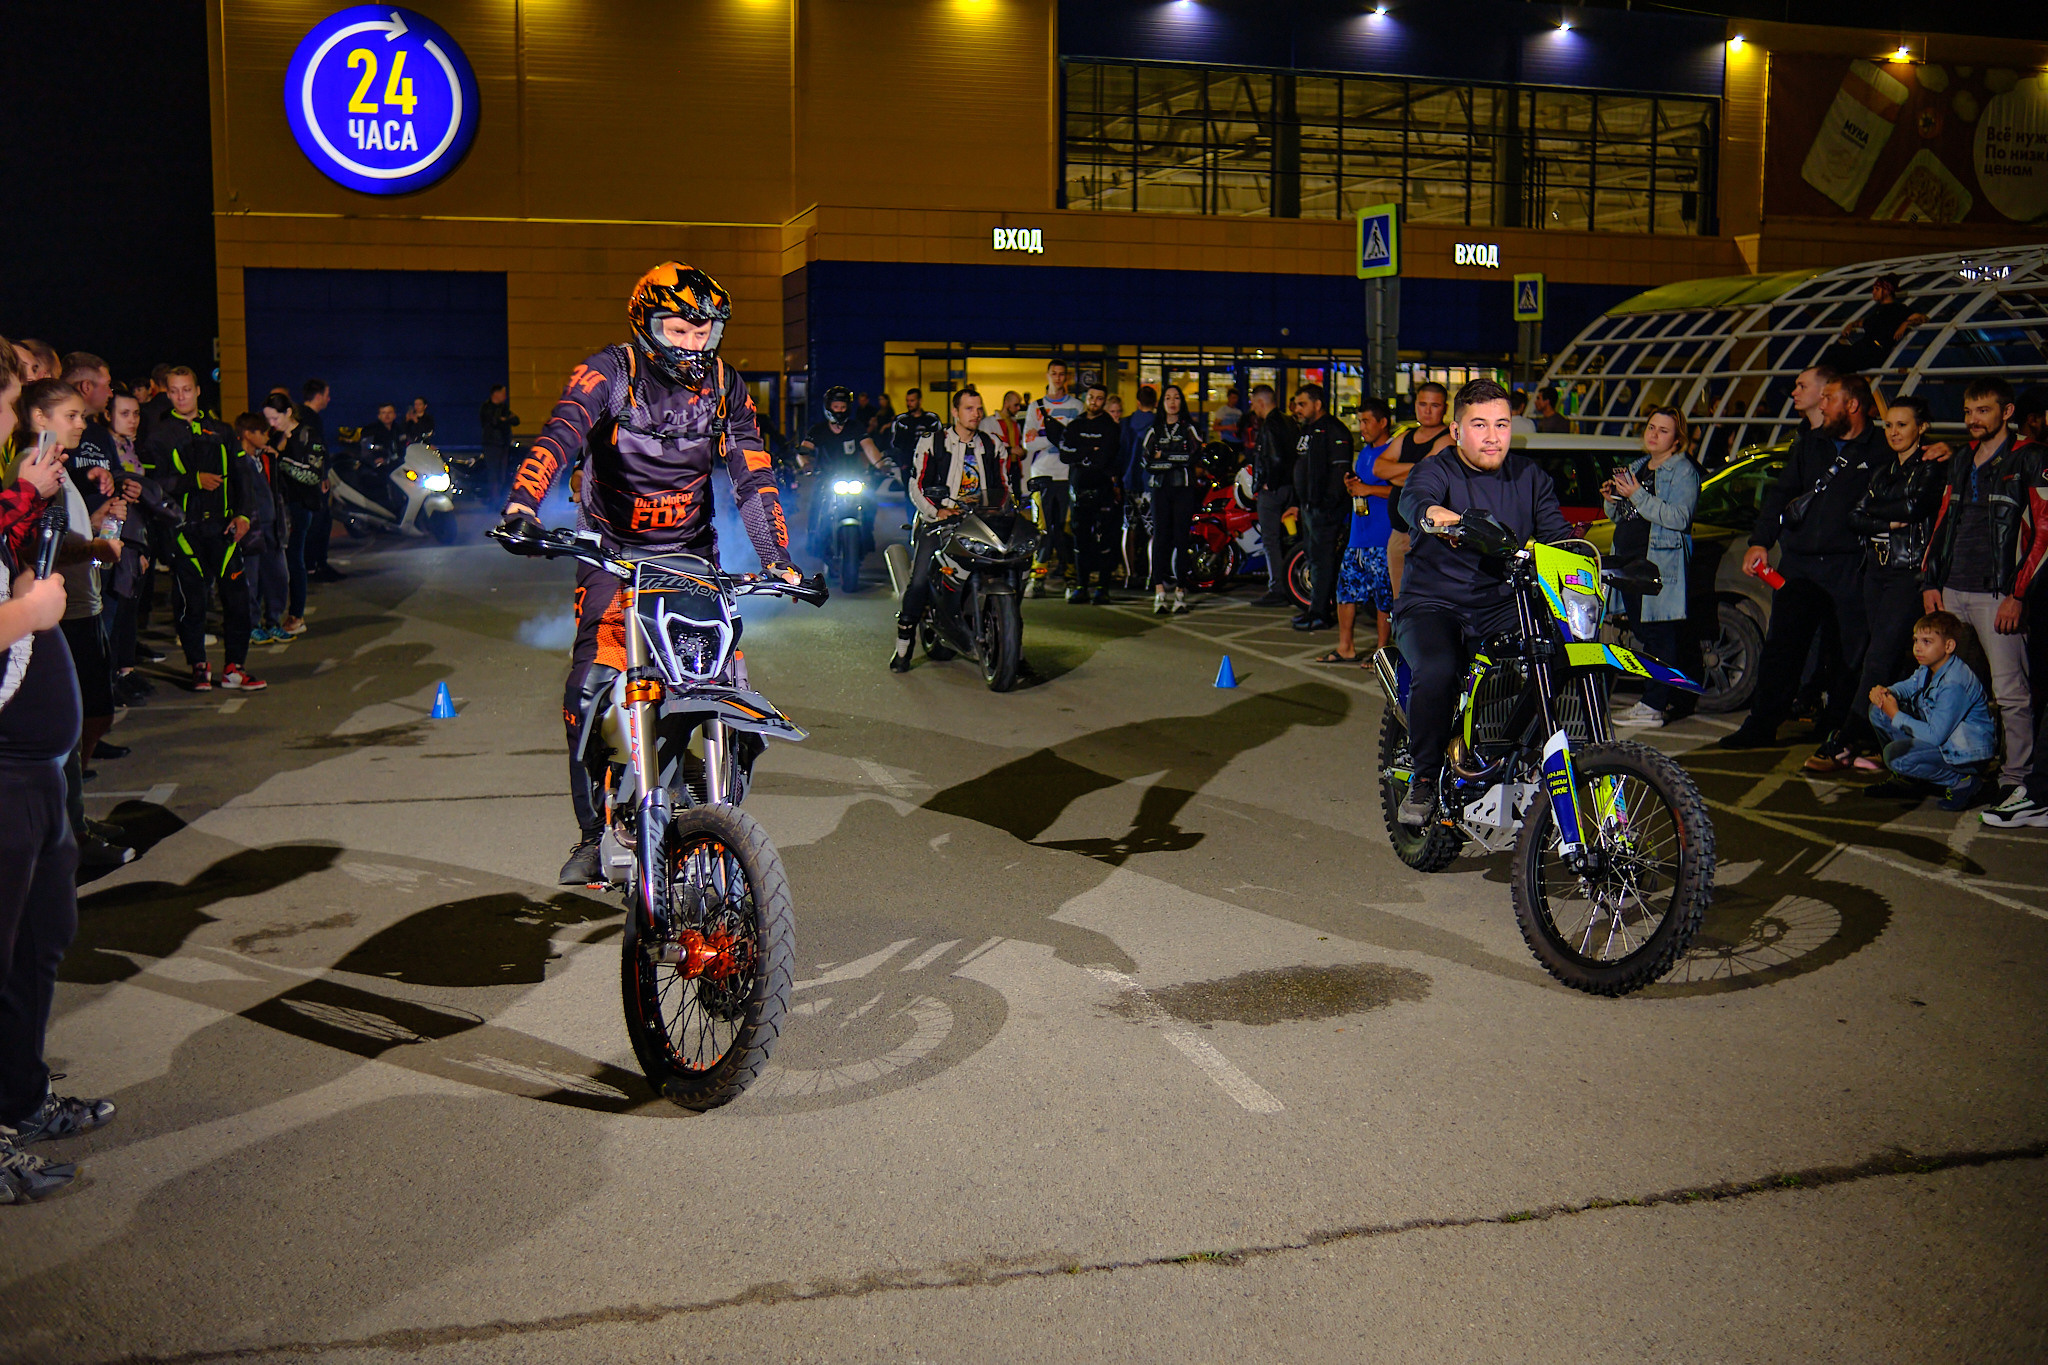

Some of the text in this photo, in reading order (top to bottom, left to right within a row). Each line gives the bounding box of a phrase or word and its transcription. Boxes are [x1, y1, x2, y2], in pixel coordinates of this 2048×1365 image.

[346, 48, 418, 115] 24
[348, 118, 419, 152] ЧАСА
[1985, 144, 2048, 161] По низк
[1984, 163, 2033, 177] ценам
[993, 227, 1043, 253] ВХОД
[1455, 242, 1499, 269] ВХОД
[634, 497, 659, 508] Dirt
[630, 502, 691, 530] FOX
